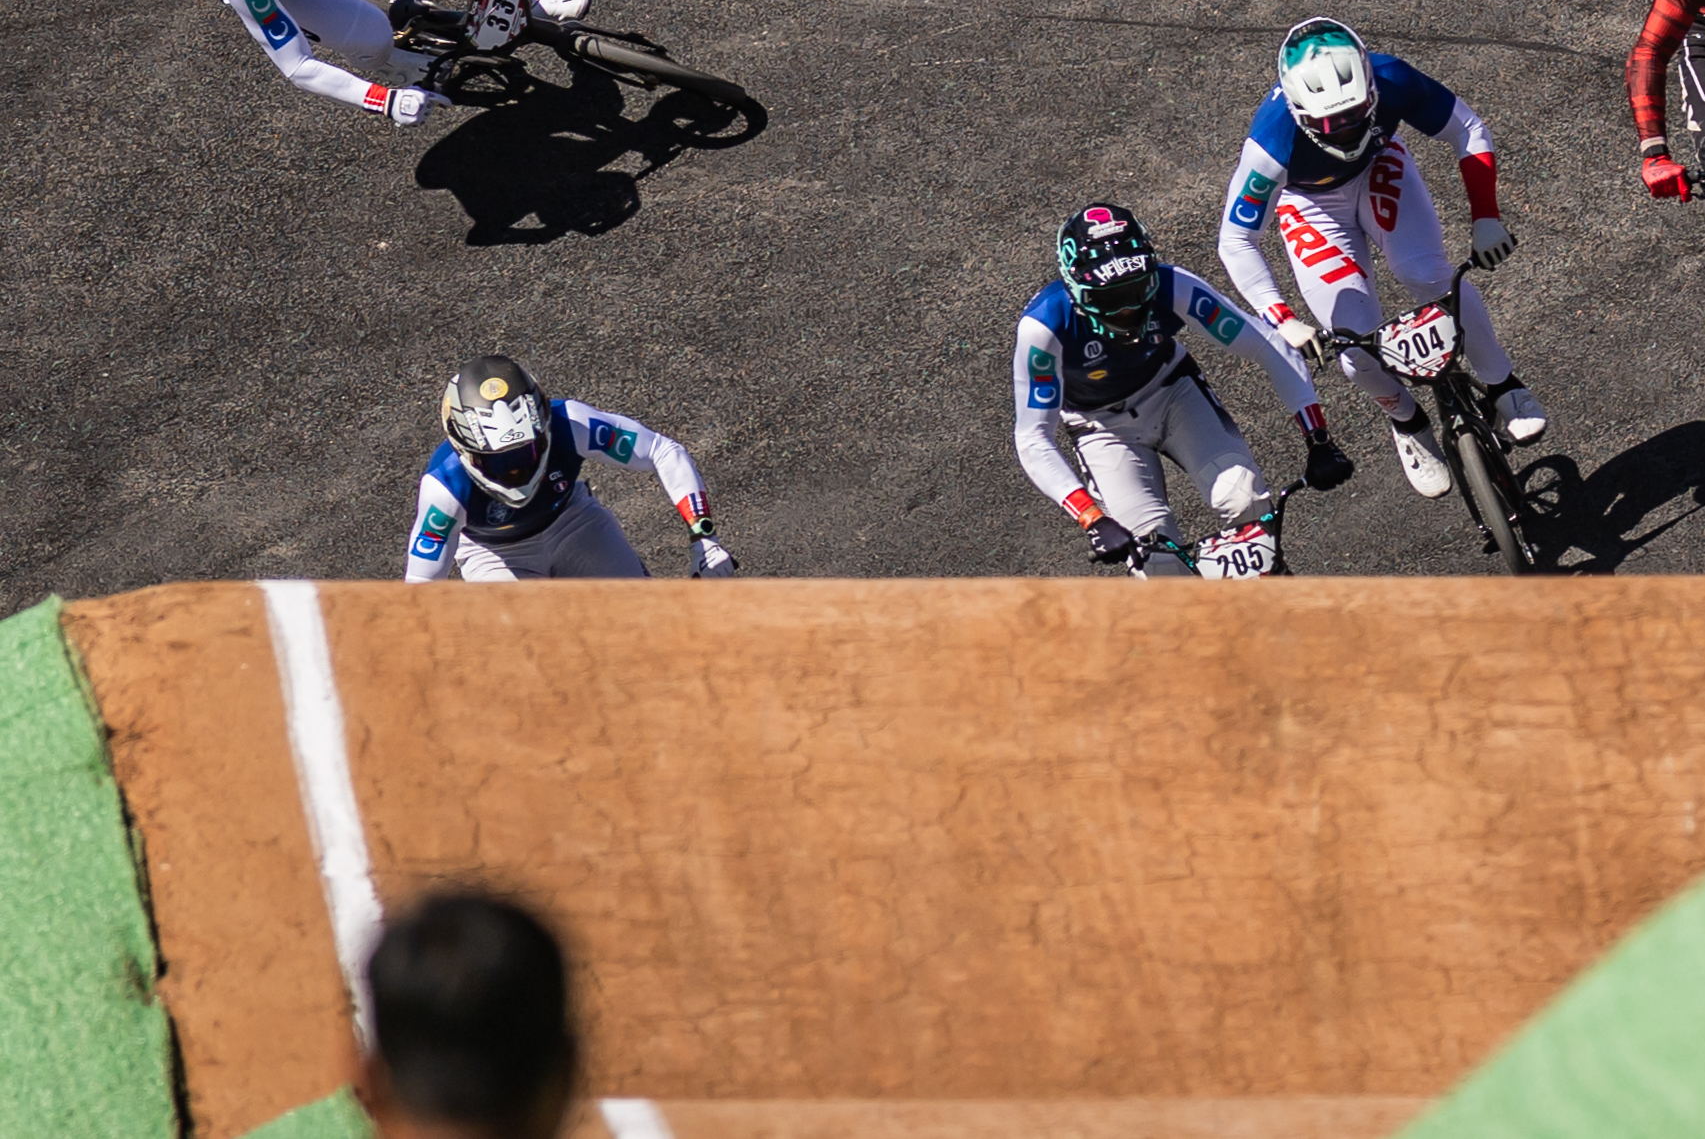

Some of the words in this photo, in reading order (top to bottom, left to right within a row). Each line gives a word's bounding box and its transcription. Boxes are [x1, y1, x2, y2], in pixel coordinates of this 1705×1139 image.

[1235, 176, 1271, 223] CIC
[1092, 254, 1149, 285] HELLFEST
[1194, 296, 1240, 340] CIC
[1396, 324, 1446, 365] 204
[1030, 353, 1057, 404] CIC
[594, 423, 634, 459] CIC
[1216, 543, 1265, 580] 205
